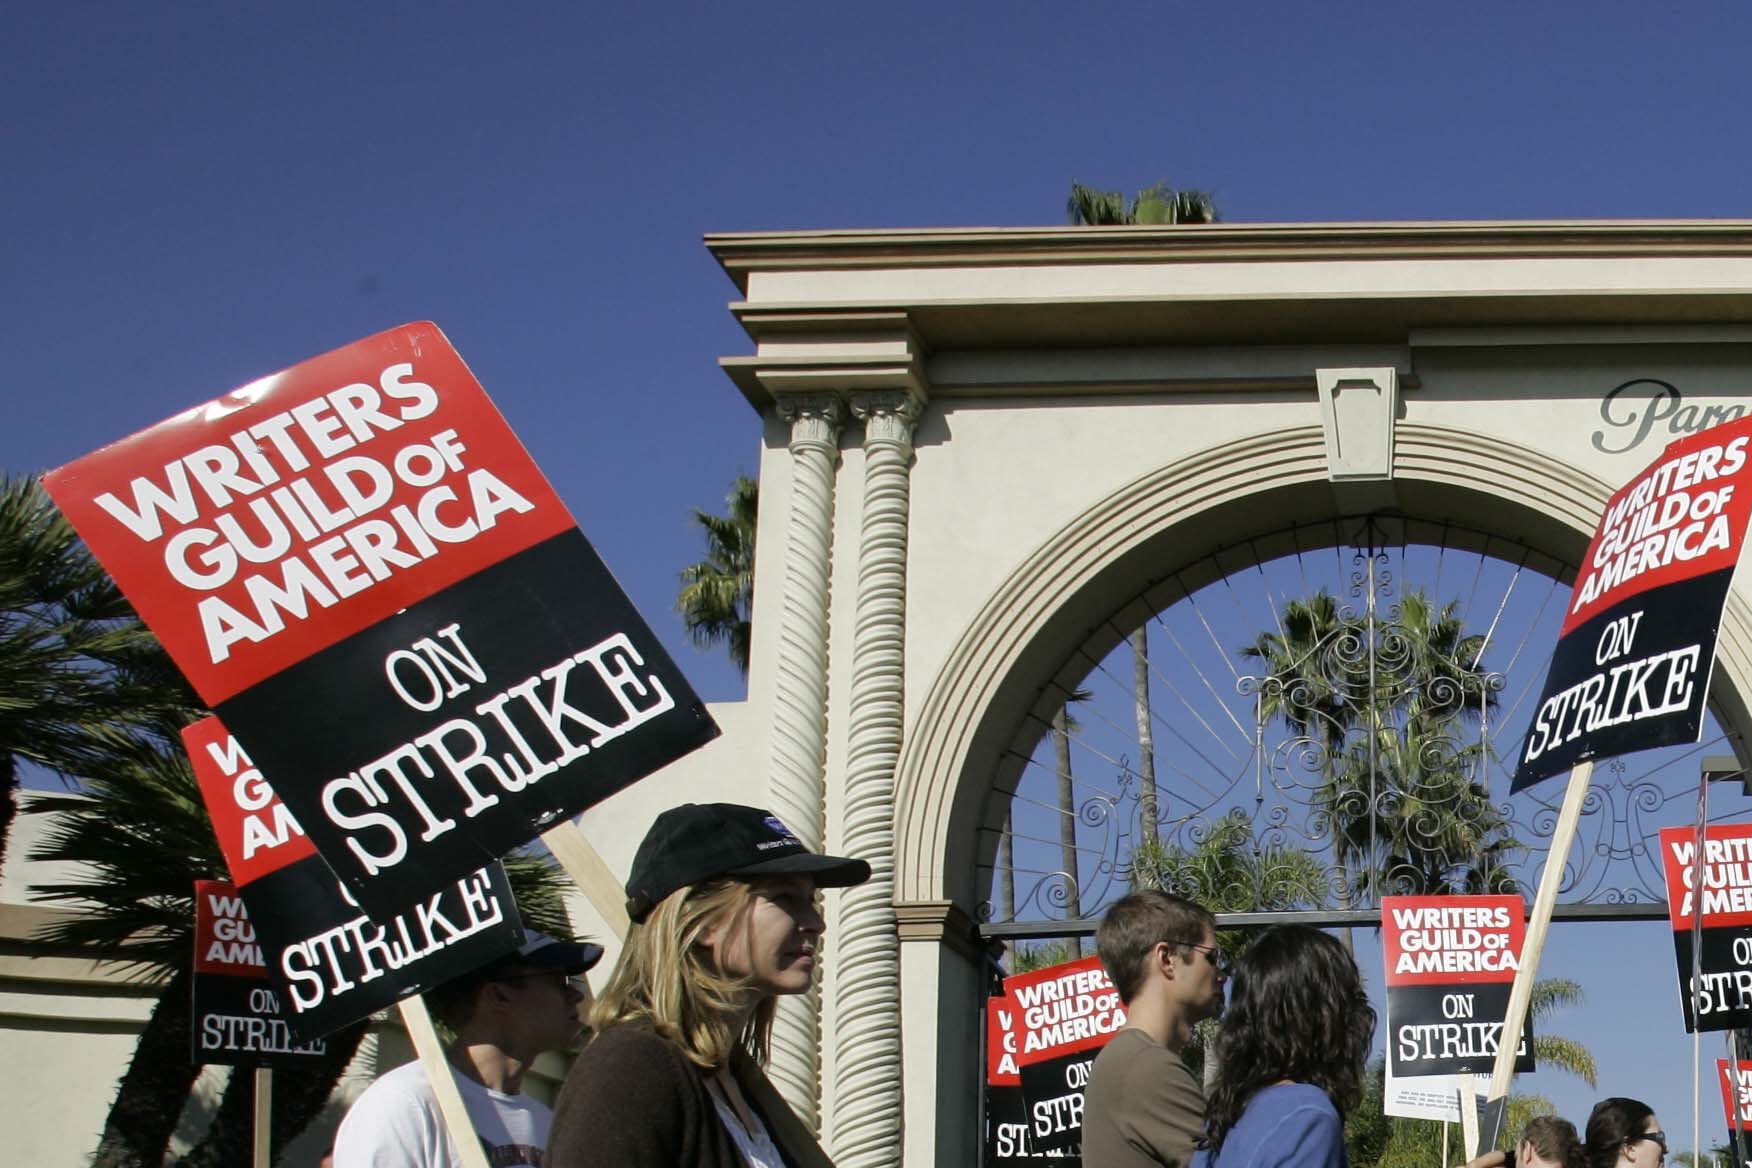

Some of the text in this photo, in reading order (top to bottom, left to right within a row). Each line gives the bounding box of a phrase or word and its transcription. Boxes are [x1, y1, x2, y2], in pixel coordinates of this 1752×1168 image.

[94, 361, 439, 543] WRITERS
[164, 428, 468, 591] GUILD OF
[1602, 435, 1750, 536] WRITERS
[1592, 485, 1735, 569] GUILD OF
[197, 467, 536, 664] AMERICA
[1572, 514, 1730, 615] AMERICA
[1595, 610, 1643, 666] ON
[384, 623, 488, 711] ON
[1524, 644, 1701, 764] STRIKE
[322, 632, 675, 876] STRIKE
[281, 868, 503, 1013] STRIKE
[1392, 907, 1510, 929] WRITERS
[1400, 929, 1509, 951] GUILD OF
[1395, 950, 1520, 974] AMERICA
[250, 989, 280, 1014] ON
[1024, 993, 1119, 1029] GUILD OF
[1442, 994, 1474, 1019] ON
[202, 1014, 326, 1055] STRI
[1024, 1009, 1127, 1054] AMERICA
[1066, 1060, 1093, 1089] ON
[1034, 1093, 1085, 1138] STR
